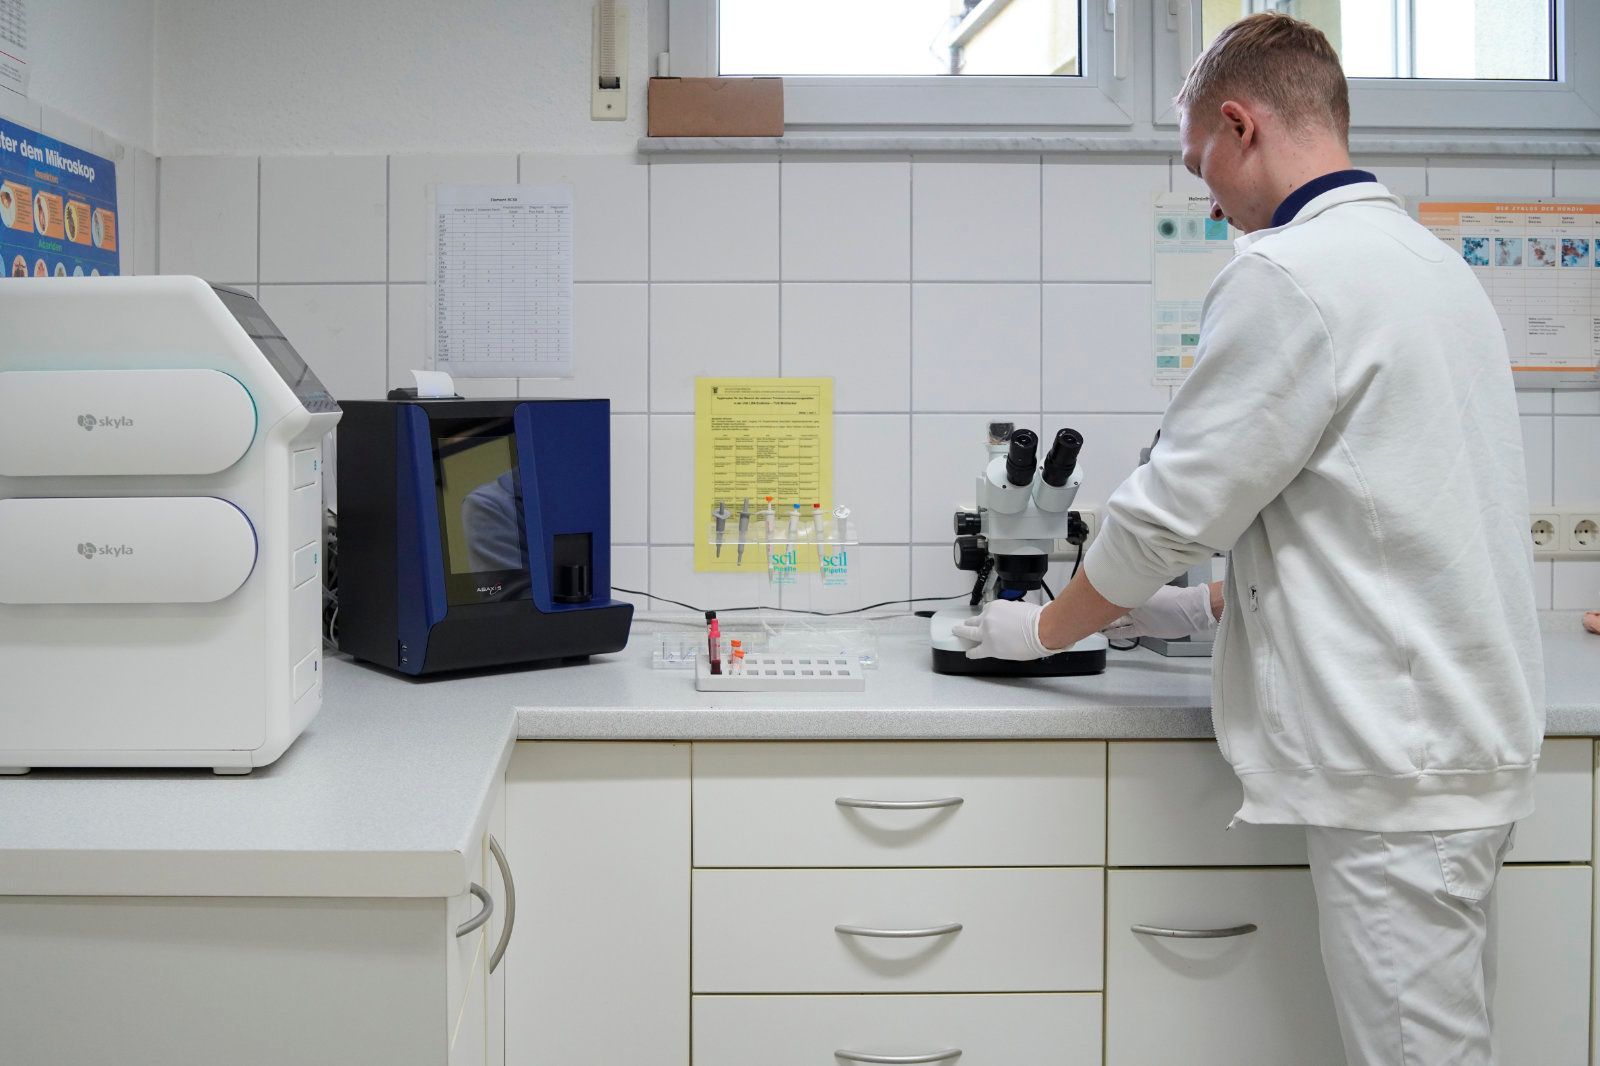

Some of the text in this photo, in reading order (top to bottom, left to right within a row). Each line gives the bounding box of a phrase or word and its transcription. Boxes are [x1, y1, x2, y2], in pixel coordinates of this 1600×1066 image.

[0, 131, 95, 183] ter dem Mikroskop
[99, 416, 133, 429] skyla
[99, 544, 133, 558] skyla
[771, 549, 797, 566] scil
[822, 551, 847, 567] scil
